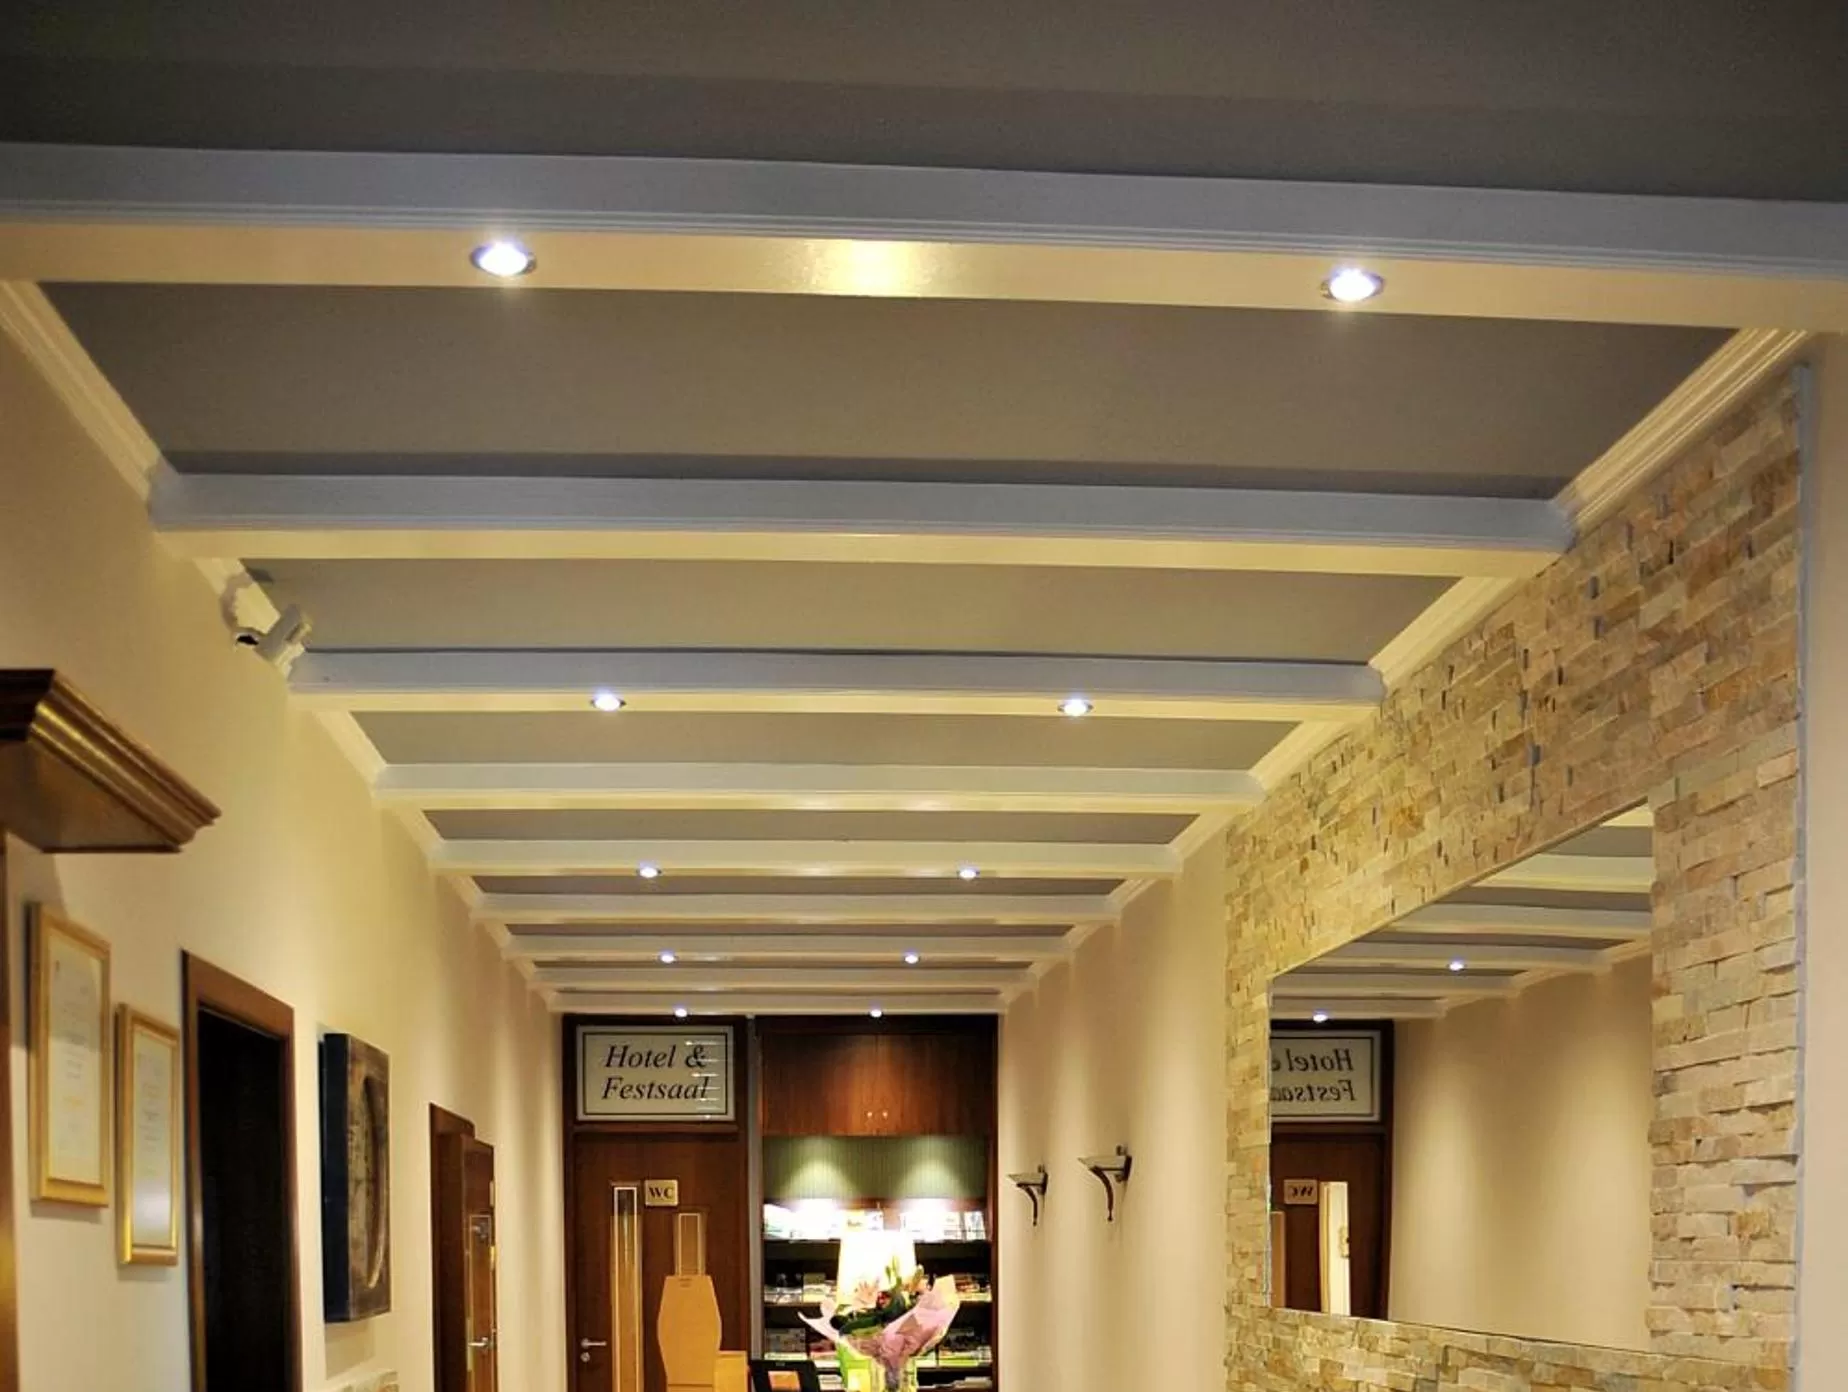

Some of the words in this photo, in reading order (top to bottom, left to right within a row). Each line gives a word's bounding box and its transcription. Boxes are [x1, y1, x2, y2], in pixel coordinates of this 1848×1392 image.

[605, 1044, 676, 1069] Hotel
[684, 1044, 708, 1069] &
[602, 1075, 711, 1101] Festsaal
[648, 1186, 674, 1200] WC
